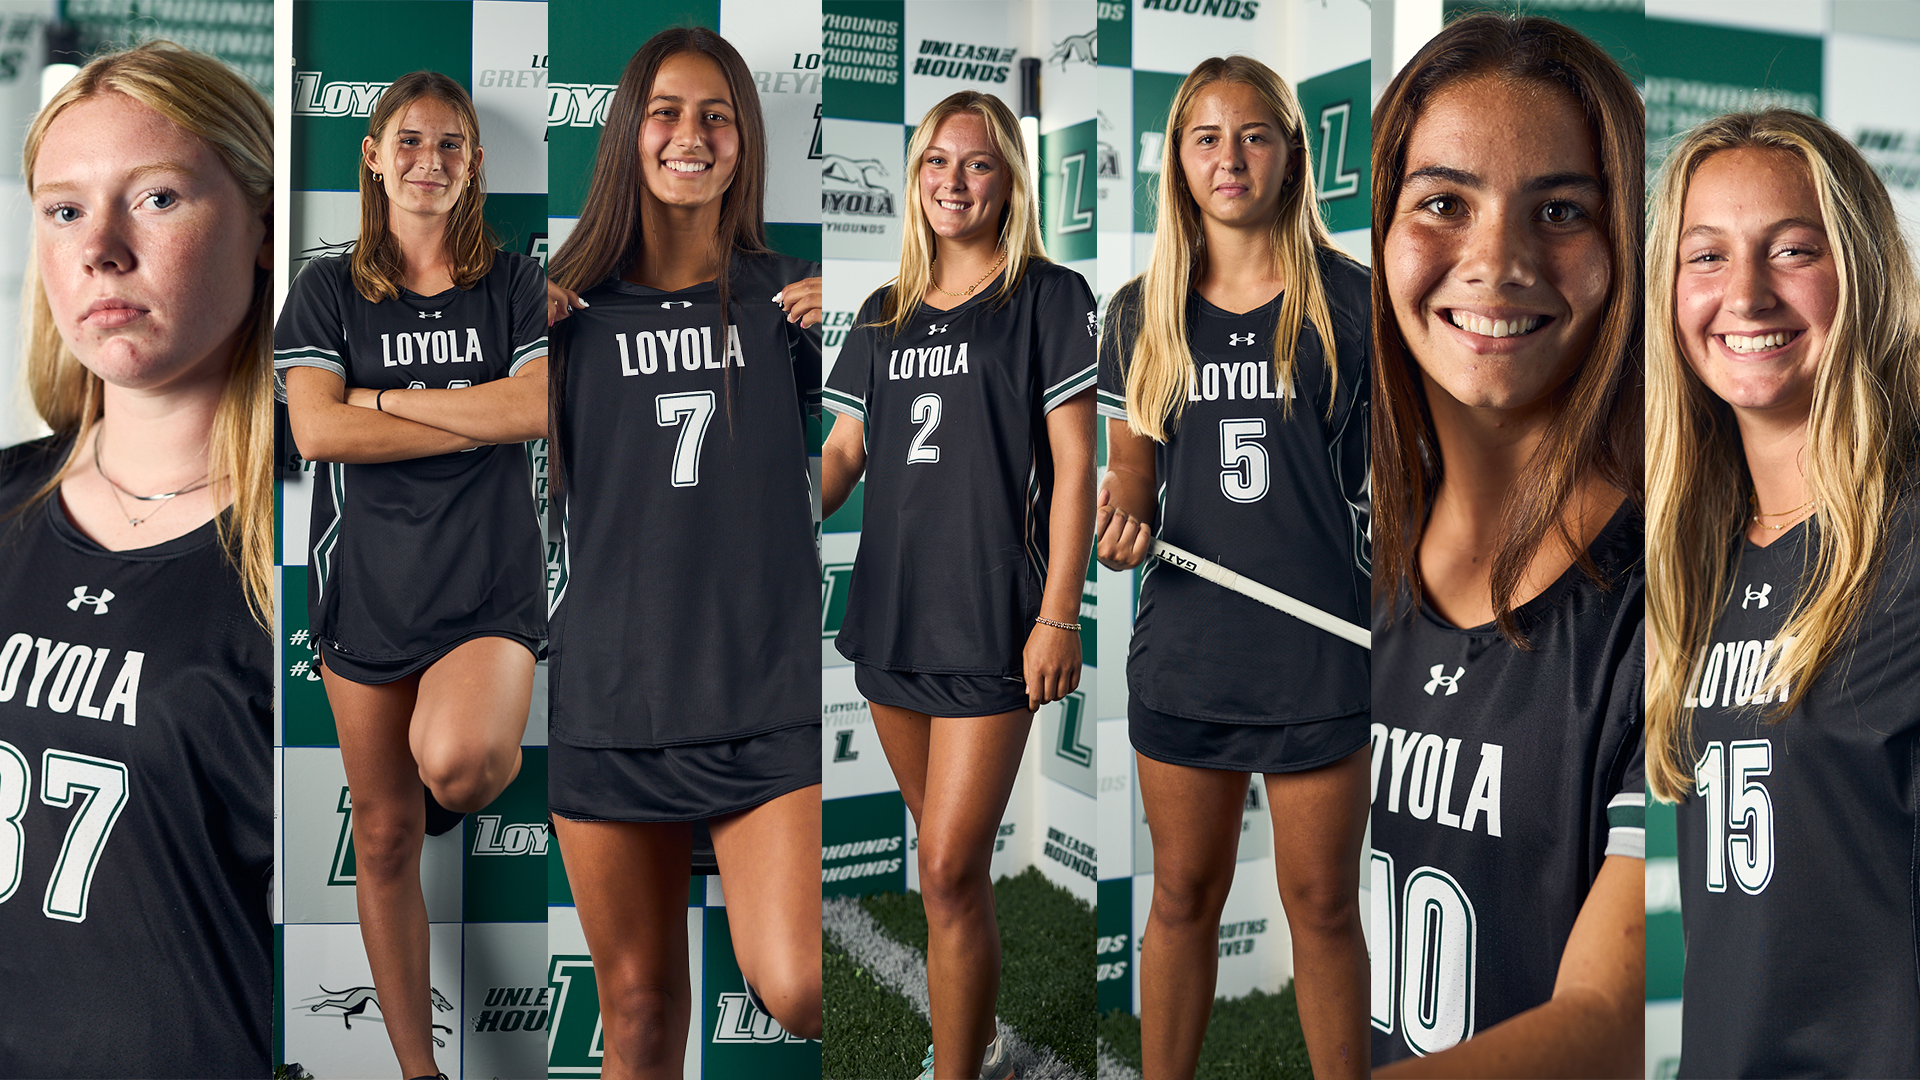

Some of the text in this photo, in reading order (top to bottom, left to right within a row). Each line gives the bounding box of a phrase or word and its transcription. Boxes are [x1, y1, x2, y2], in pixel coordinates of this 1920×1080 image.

[913, 57, 1010, 83] HOUNDS
[919, 39, 999, 62] UNLEASH
[293, 71, 396, 118] LOY
[479, 69, 548, 88] GREY
[548, 82, 619, 128] OY
[381, 328, 484, 367] LOYOLA
[616, 325, 746, 376] LOYOLA
[889, 342, 970, 381] LOYOLA
[1188, 360, 1297, 402] LOYOLA
[655, 389, 716, 488] 7
[907, 392, 943, 465] 2
[1219, 417, 1271, 504] 5
[1156, 549, 1198, 572] GAIT
[823, 701, 868, 714] LOYOLA
[823, 712, 874, 728] YHOU
[833, 729, 859, 763] L
[1694, 738, 1776, 896] 15
[1044, 841, 1097, 882] HOUNDS
[471, 1010, 548, 1033] HOU
[712, 992, 822, 1044] LO
